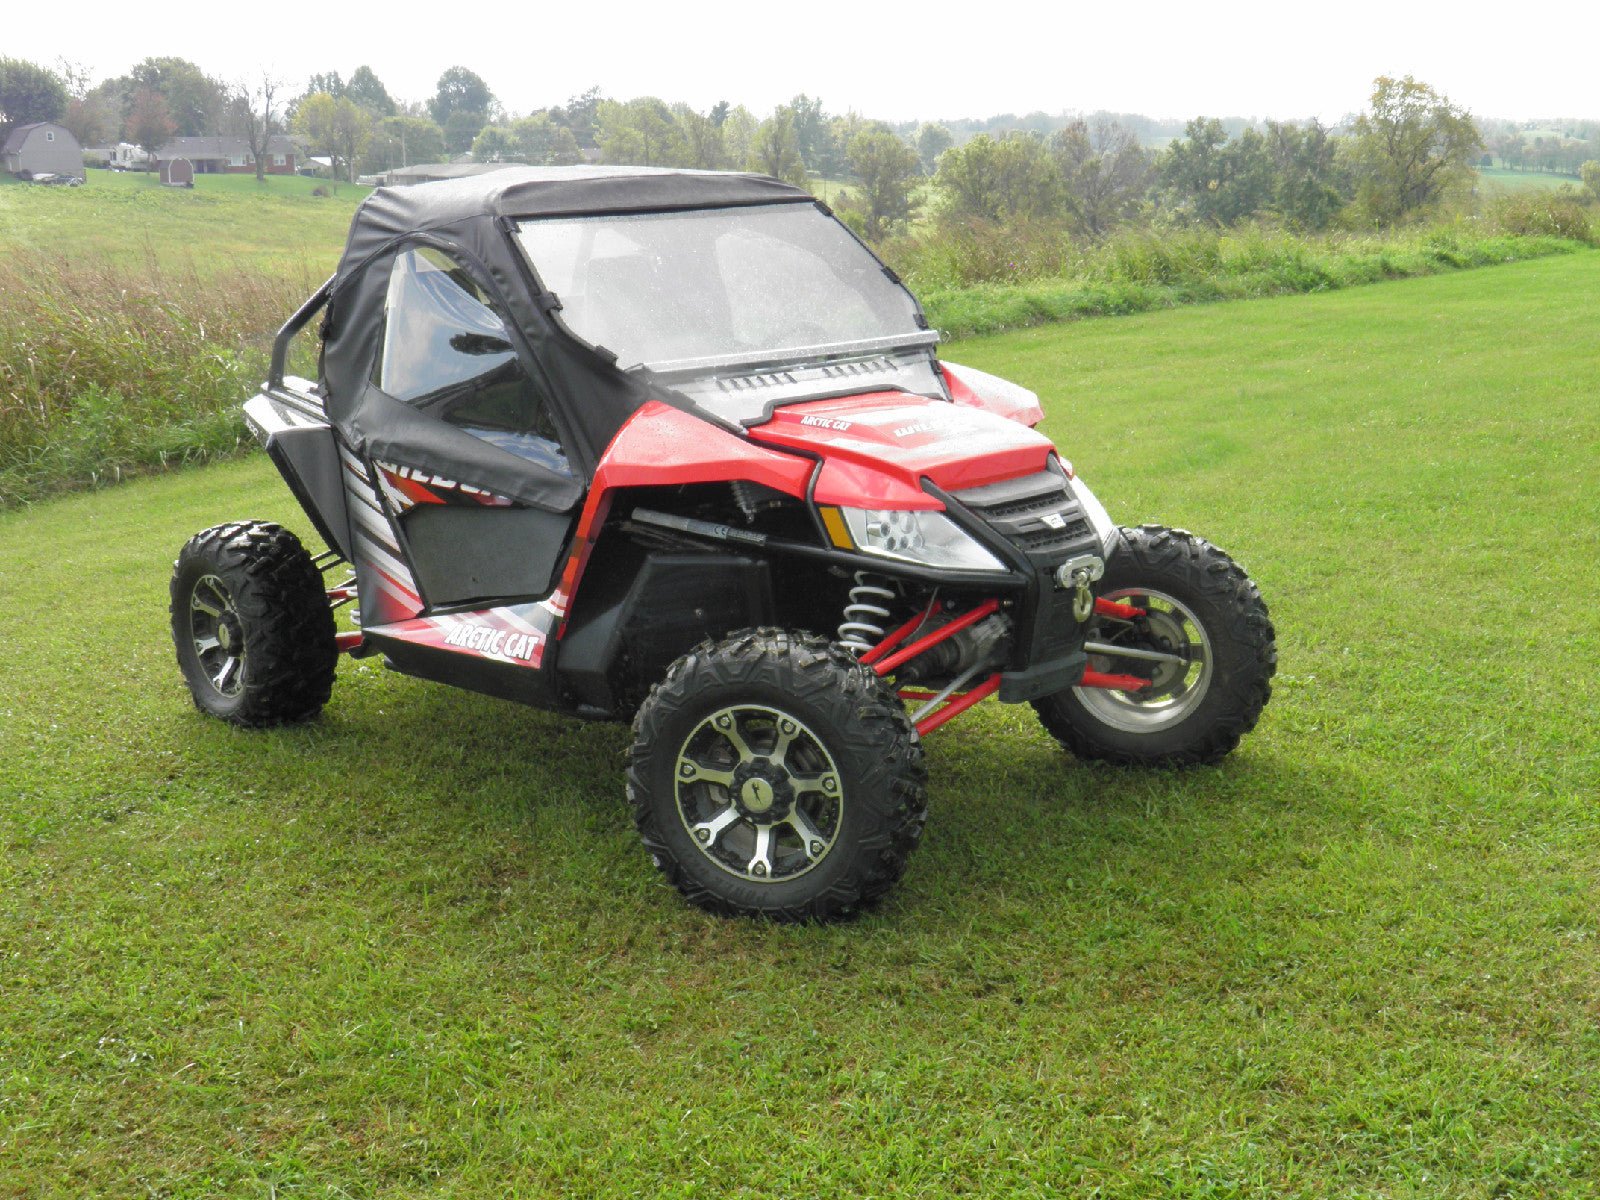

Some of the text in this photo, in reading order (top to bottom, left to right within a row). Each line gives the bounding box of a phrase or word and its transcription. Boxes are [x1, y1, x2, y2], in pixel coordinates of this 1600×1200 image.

[800, 415, 851, 431] ARCTIC CAT
[444, 623, 540, 660] ARCTIC CAT
